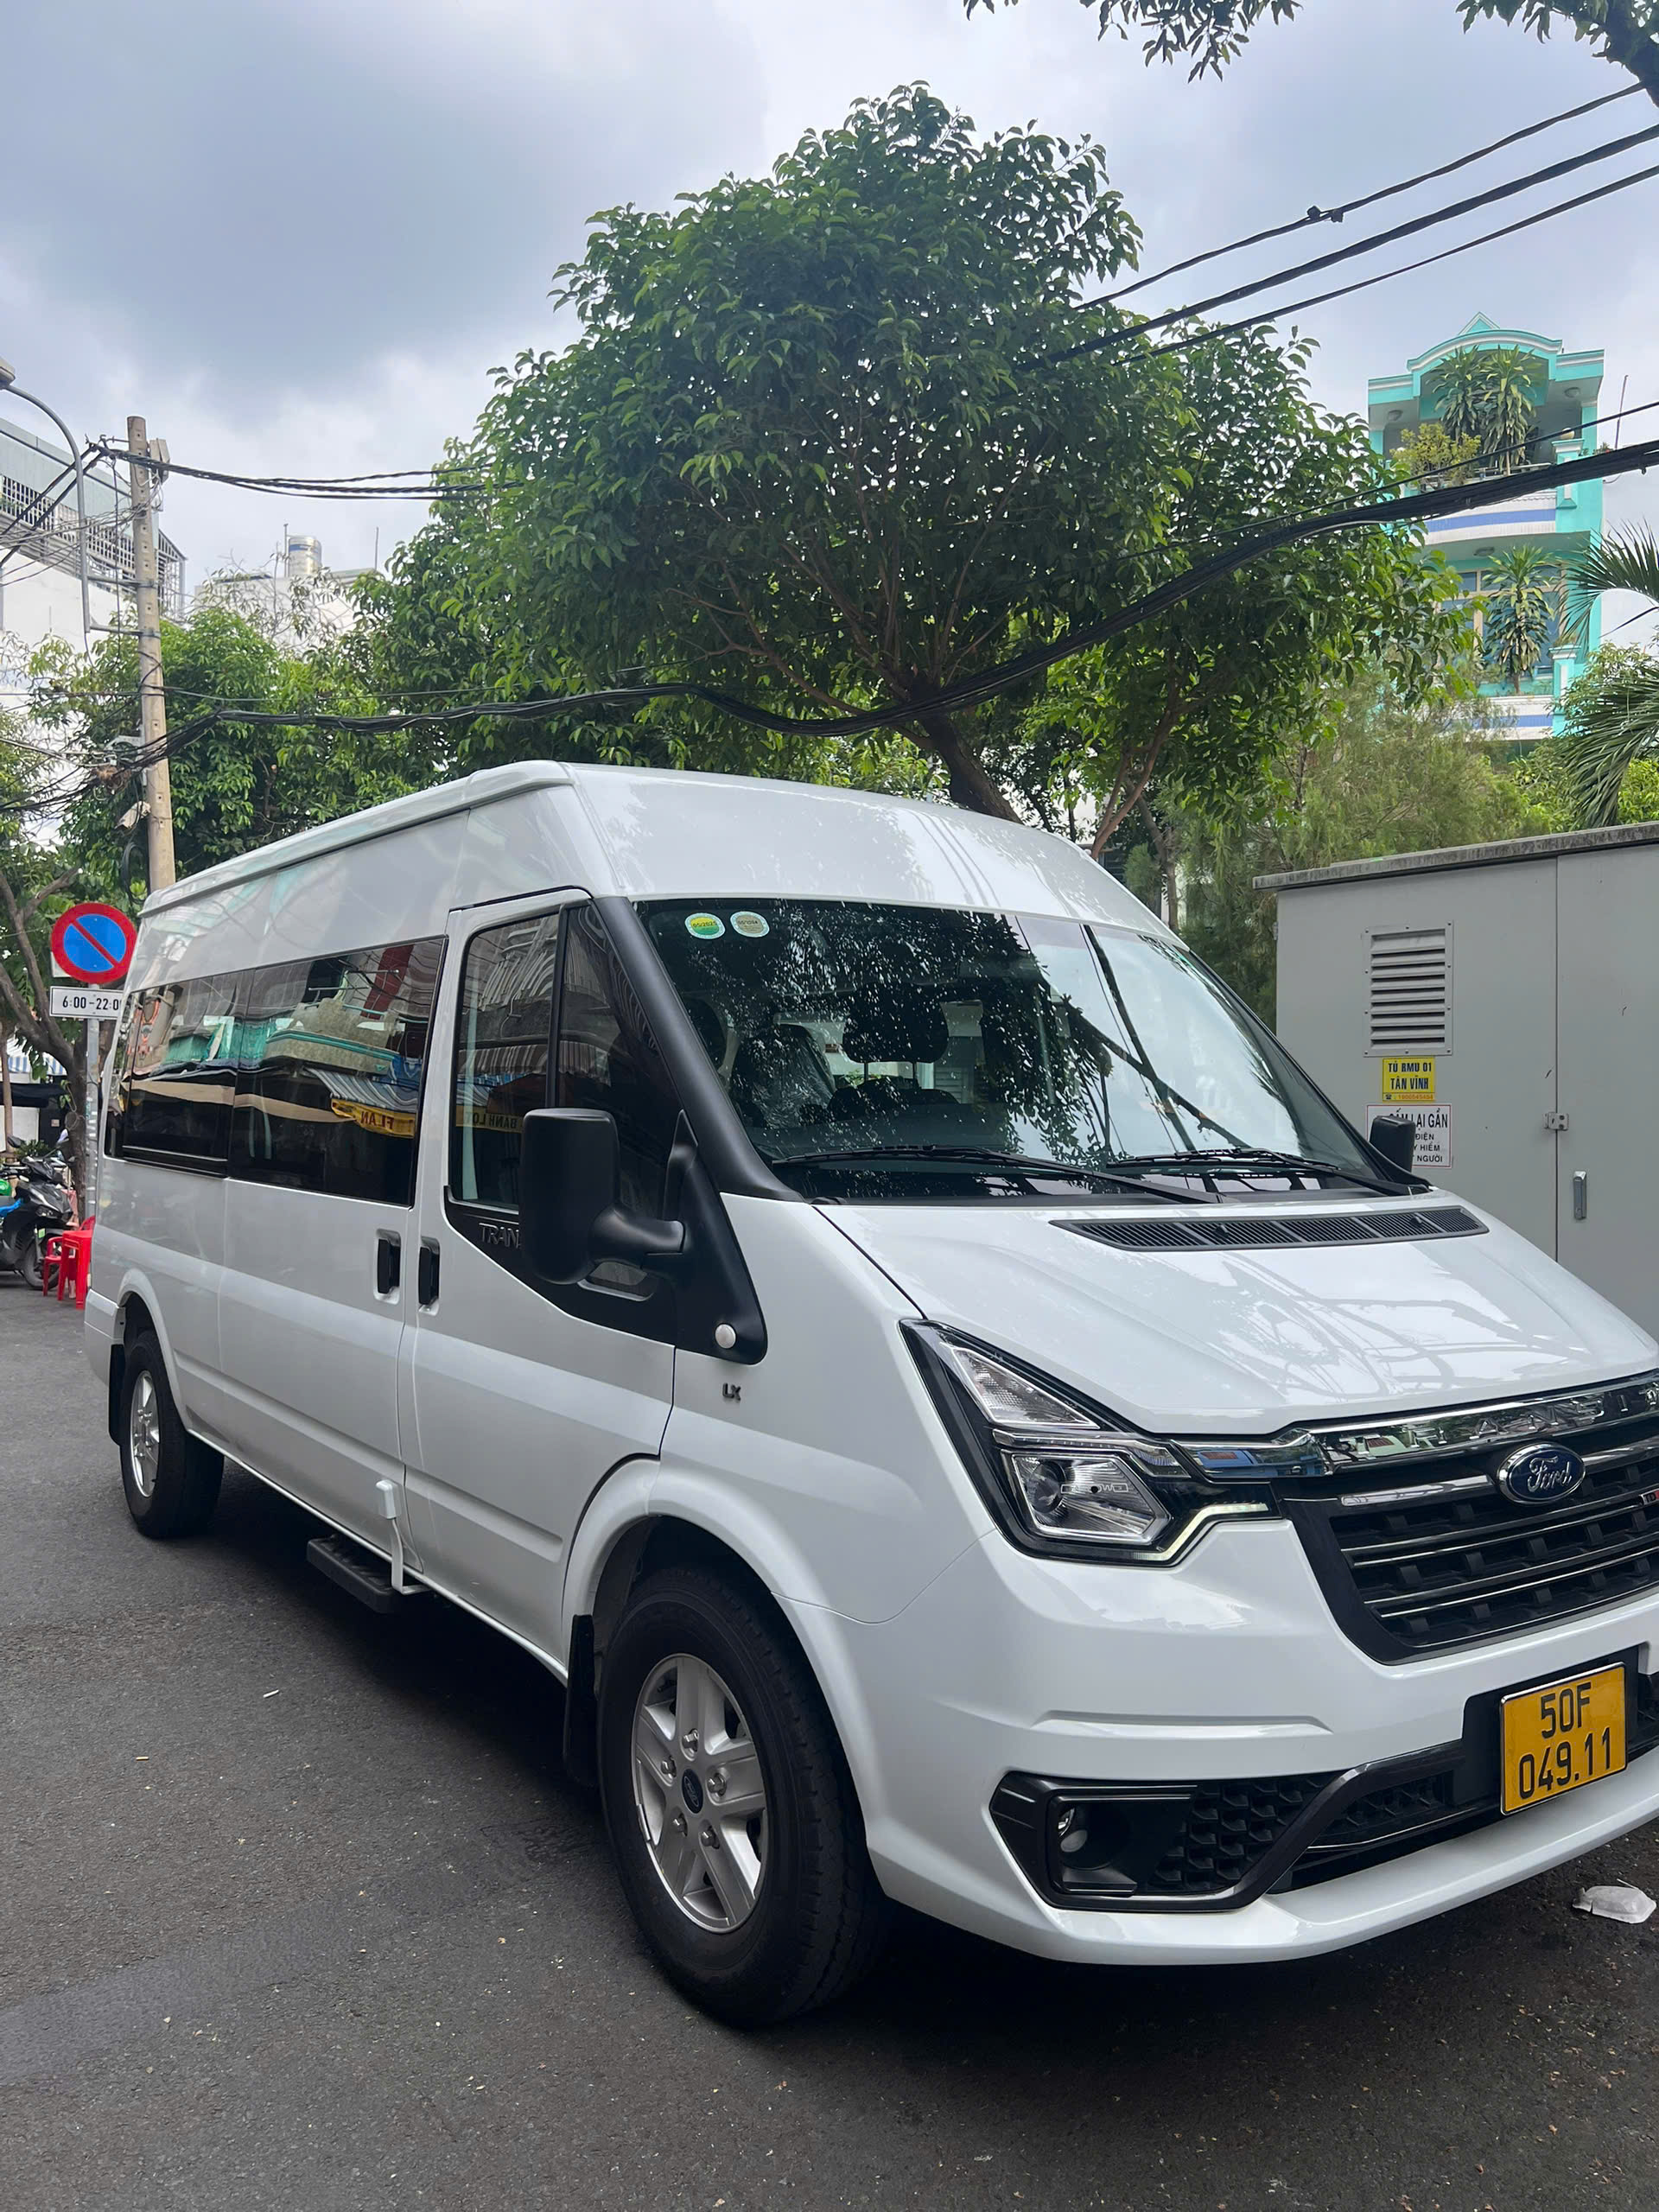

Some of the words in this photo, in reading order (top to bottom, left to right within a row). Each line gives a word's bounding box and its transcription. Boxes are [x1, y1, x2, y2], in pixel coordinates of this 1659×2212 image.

[1388, 1060, 1398, 1072] TỦ
[1402, 1062, 1420, 1072] RMU
[1422, 1062, 1432, 1072] 01
[1390, 1075, 1407, 1090] TÂN
[479, 1223, 520, 1249] TRAN
[722, 1382, 741, 1402] LX
[1527, 1457, 1573, 1493] Ford
[1541, 1681, 1592, 1748] 50F
[1518, 1726, 1611, 1801] 049.11
